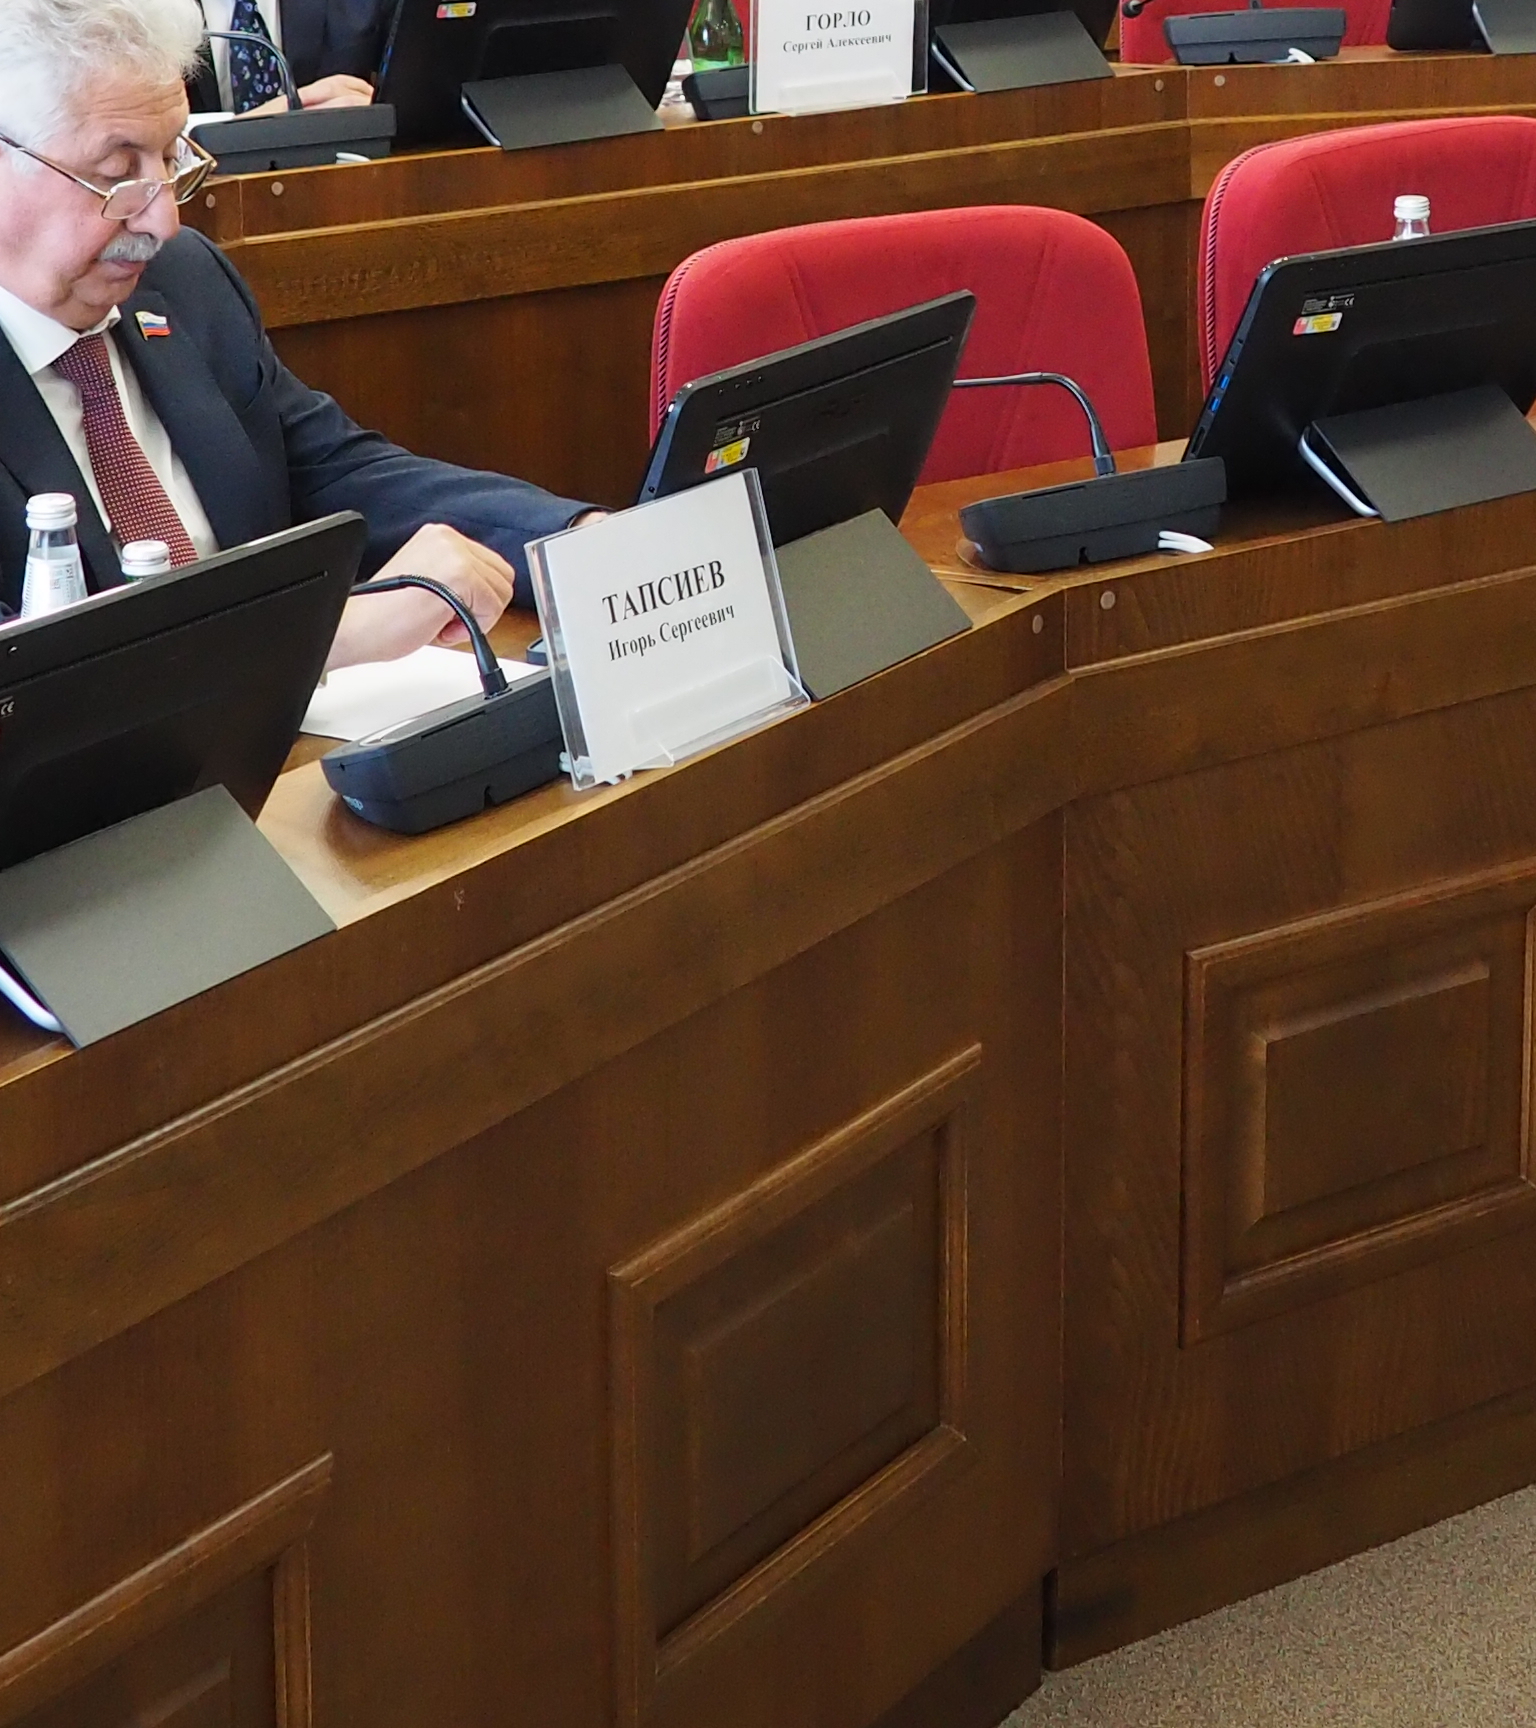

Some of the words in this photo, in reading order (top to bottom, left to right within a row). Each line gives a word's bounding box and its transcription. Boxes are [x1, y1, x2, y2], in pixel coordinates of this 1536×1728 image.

[806, 10, 871, 31] ГОРЛО
[782, 38, 823, 54] Сергей
[826, 34, 892, 49] Алексеевич
[602, 560, 726, 624] ТАПСИЕВ
[608, 632, 656, 662] Игорь
[659, 605, 735, 643] Сергеевич
